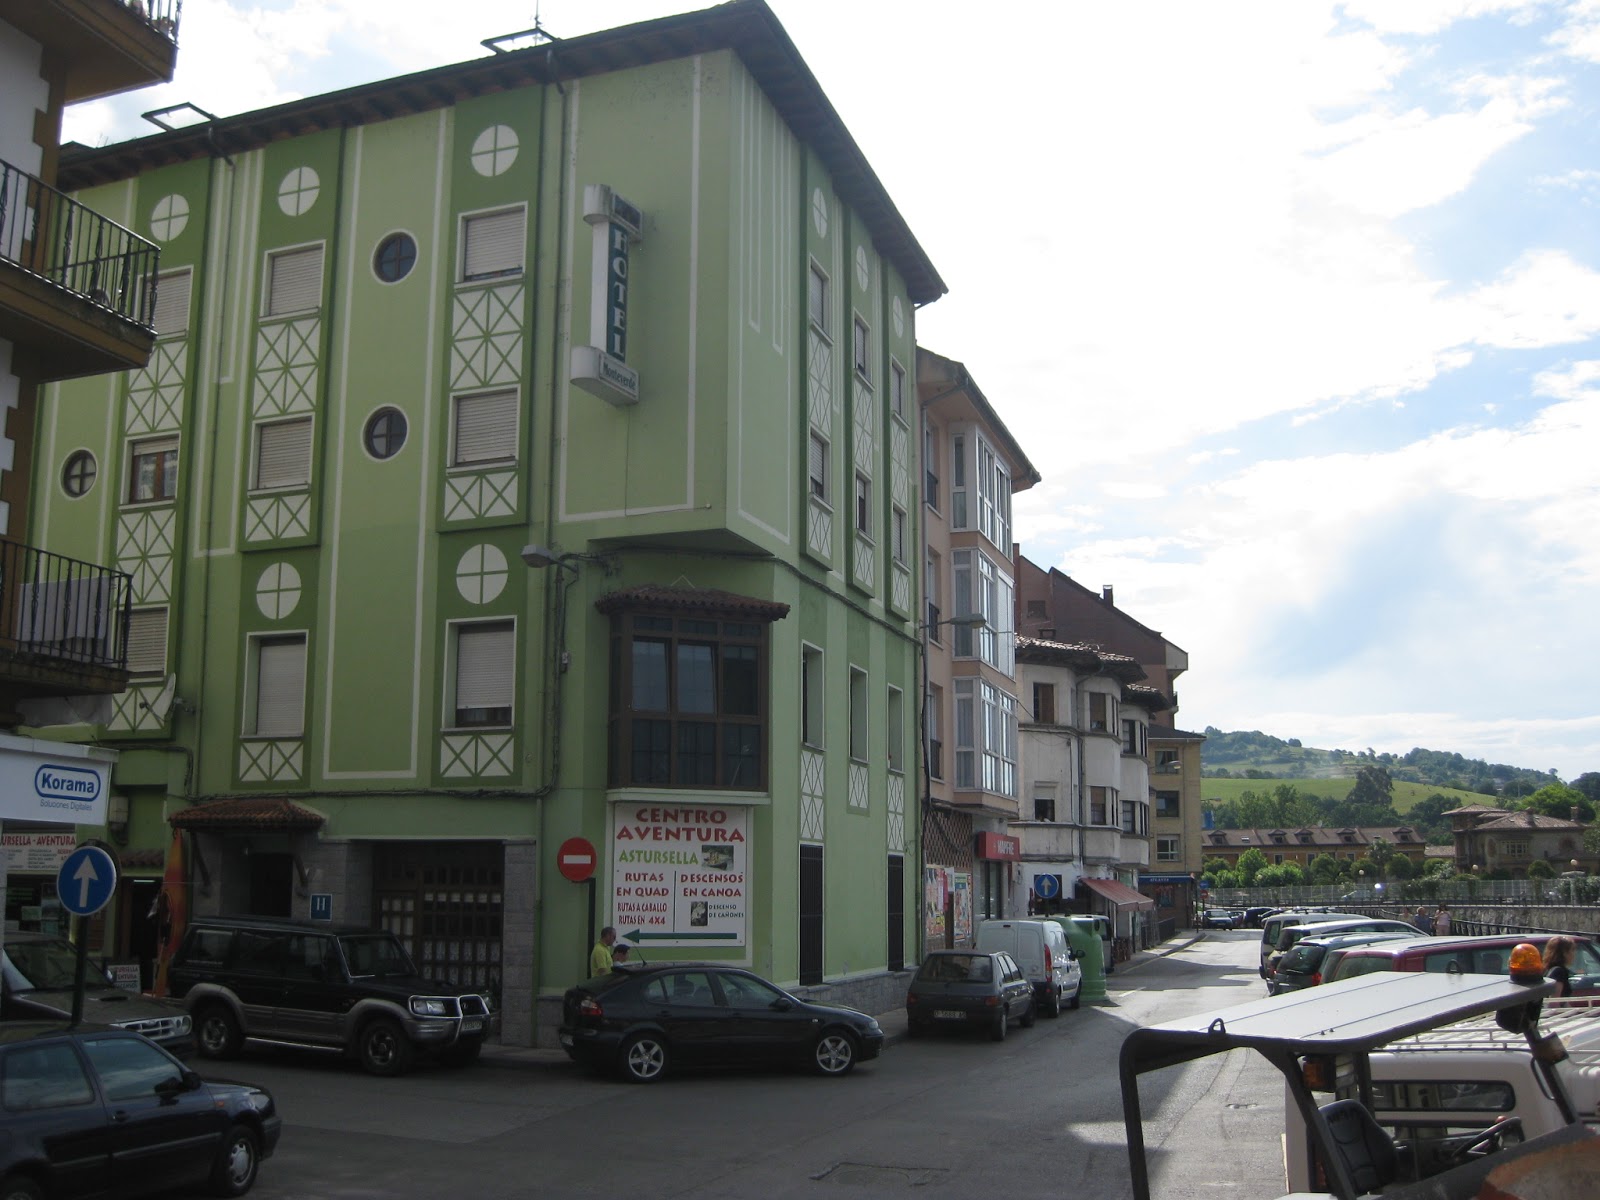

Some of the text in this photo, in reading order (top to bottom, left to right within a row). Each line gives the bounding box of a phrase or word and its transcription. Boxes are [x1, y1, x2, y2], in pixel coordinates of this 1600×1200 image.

[613, 229, 627, 356] HOTEL
[603, 361, 636, 391] Monteverde
[42, 772, 95, 794] Korama
[40, 799, 93, 812] Soluciones Digitales
[636, 808, 727, 824] CENTRO
[616, 826, 745, 842] AVENTURA
[2, 835, 31, 846] URSELLA
[37, 835, 76, 846] AVENTURA
[619, 849, 699, 865] ASTURSELLA
[625, 872, 664, 882] RUTAS
[680, 874, 743, 883] DESCENSOS
[616, 887, 669, 898] EN QUAD
[683, 888, 742, 897] EN CANOA
[617, 902, 668, 913] RUTAS A CABALLO
[618, 915, 666, 925] RUTAS EN 4X4
